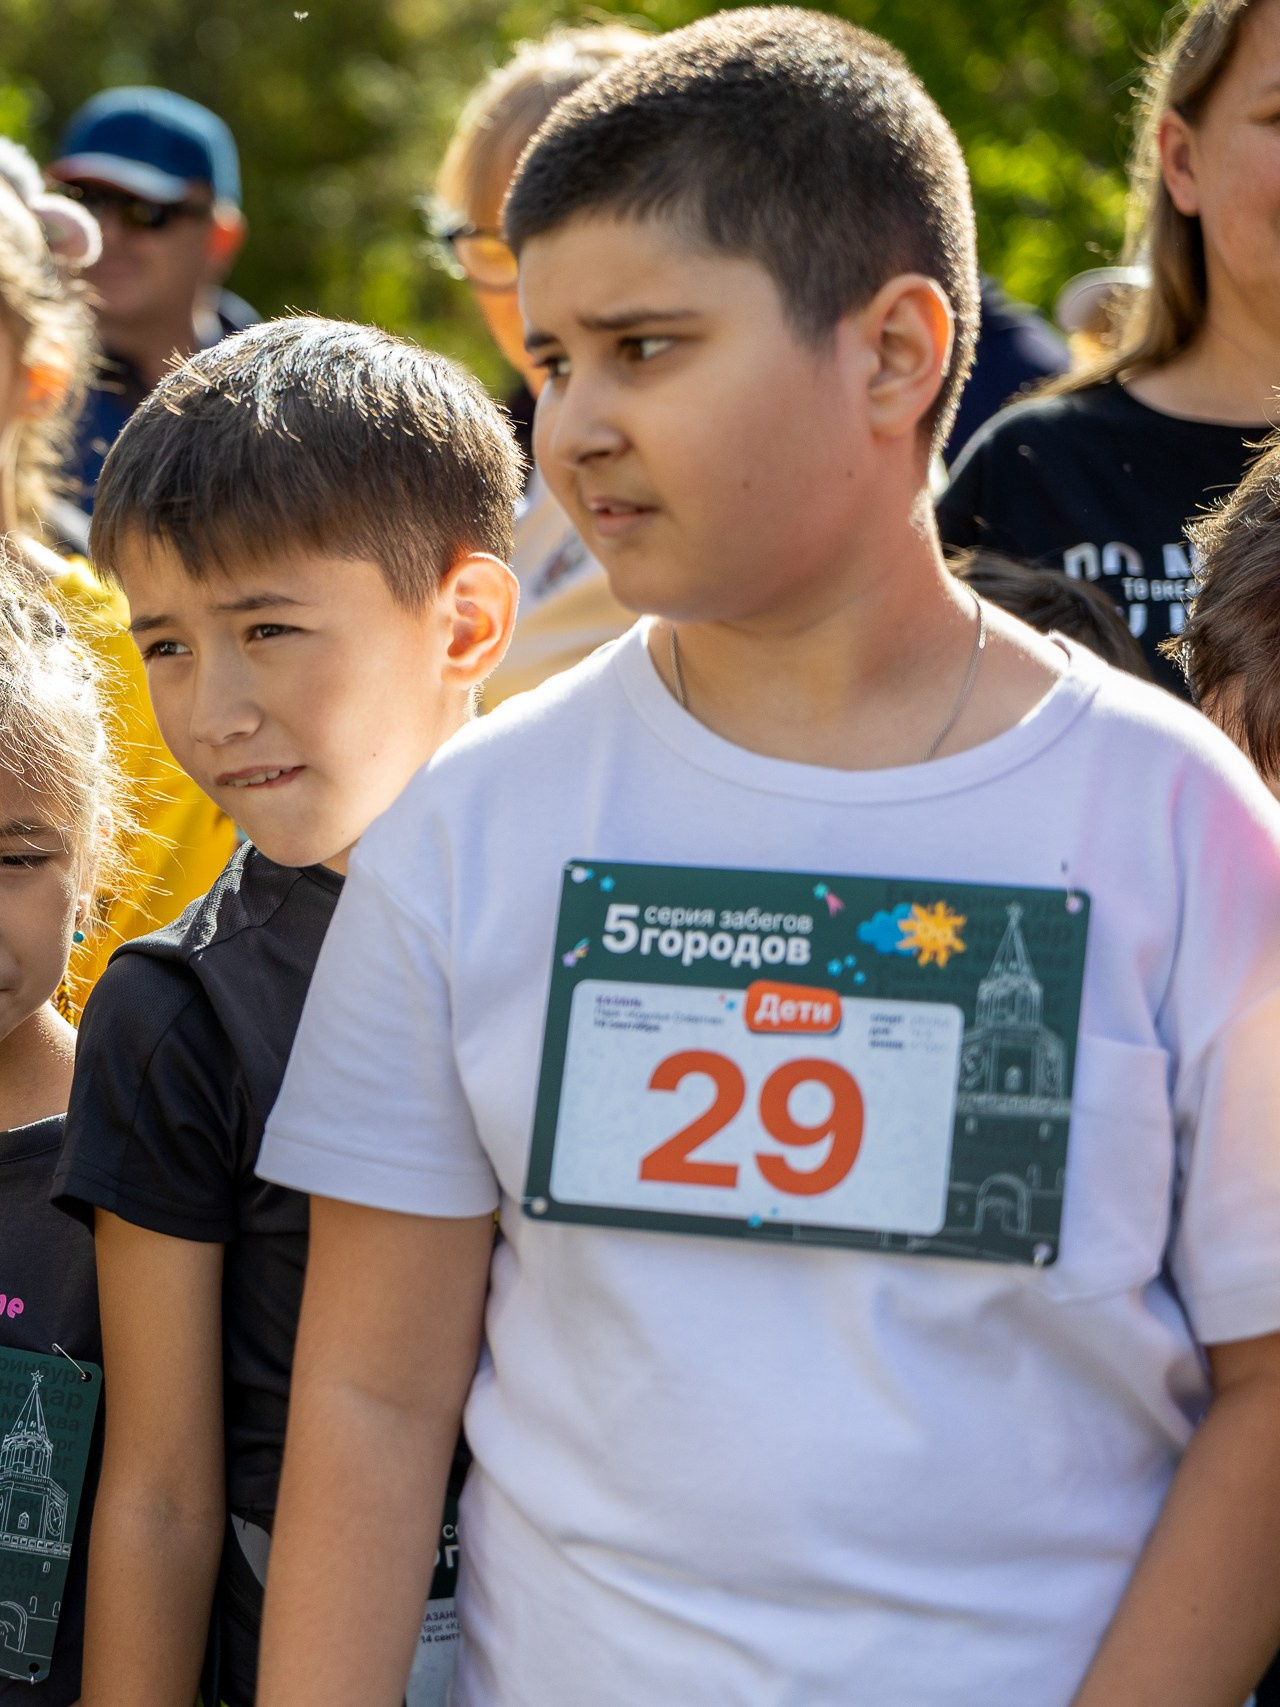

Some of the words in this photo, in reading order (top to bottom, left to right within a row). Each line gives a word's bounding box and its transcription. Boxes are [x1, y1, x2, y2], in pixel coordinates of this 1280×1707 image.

[602, 903, 640, 954] 5
[639, 927, 811, 970] городов
[644, 905, 715, 929] серия
[719, 907, 814, 934] забегов
[753, 992, 833, 1027] Дети
[638, 1048, 865, 1196] 29
